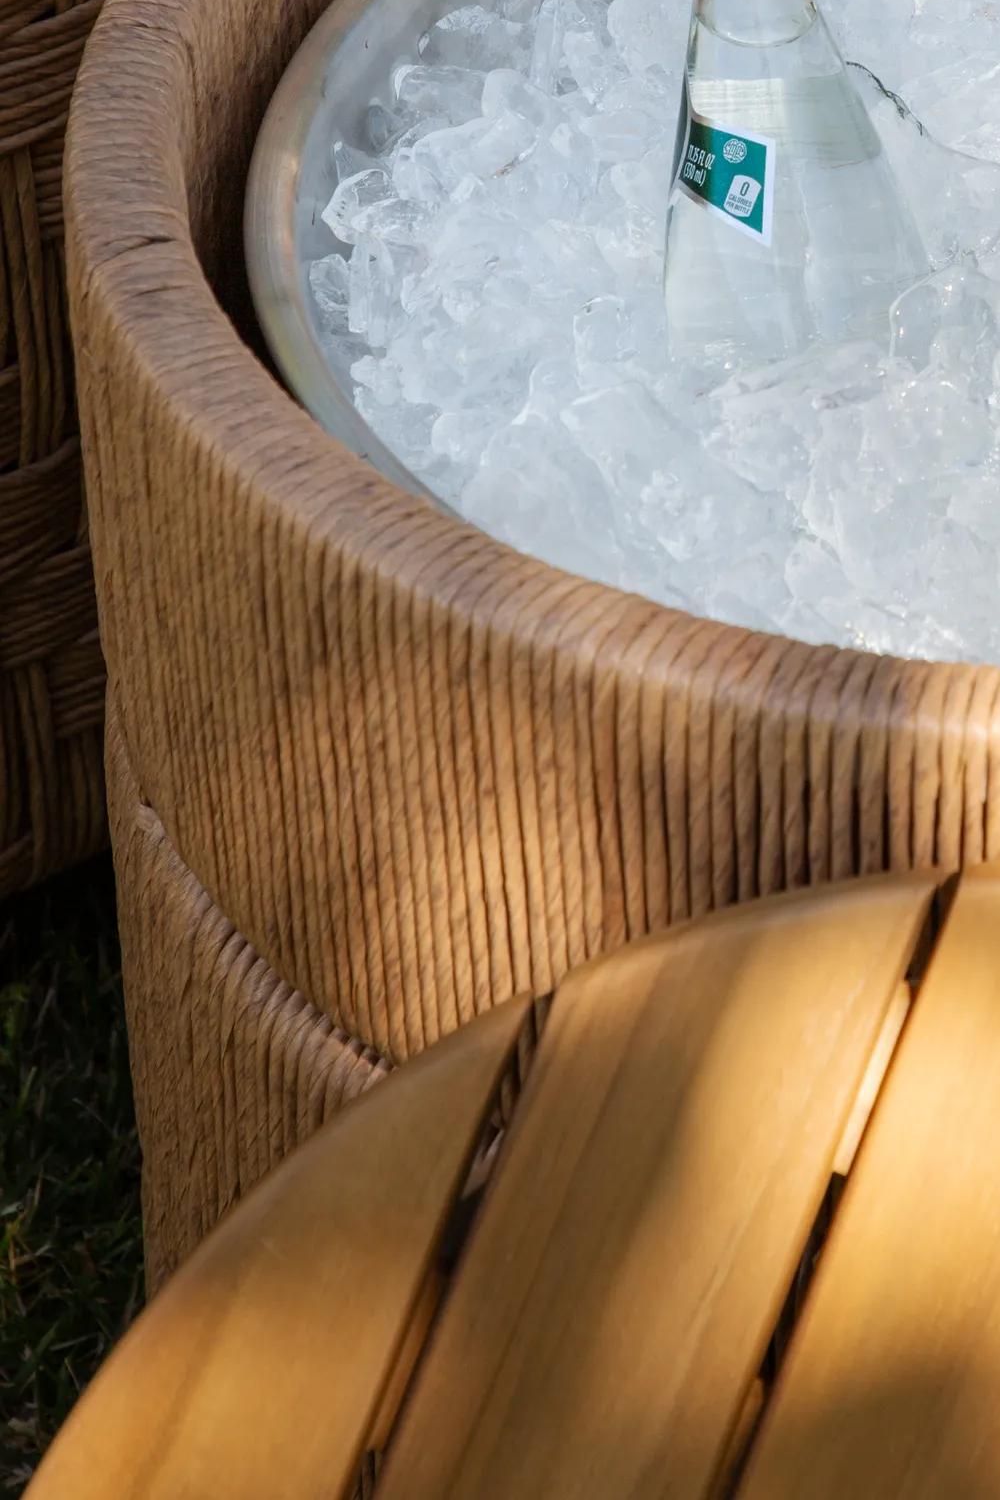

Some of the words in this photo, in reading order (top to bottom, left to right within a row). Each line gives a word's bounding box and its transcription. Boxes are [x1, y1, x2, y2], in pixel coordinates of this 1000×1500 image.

[705, 152, 716, 170] OZ
[740, 181, 750, 197] 0
[728, 193, 753, 209] CALORIES
